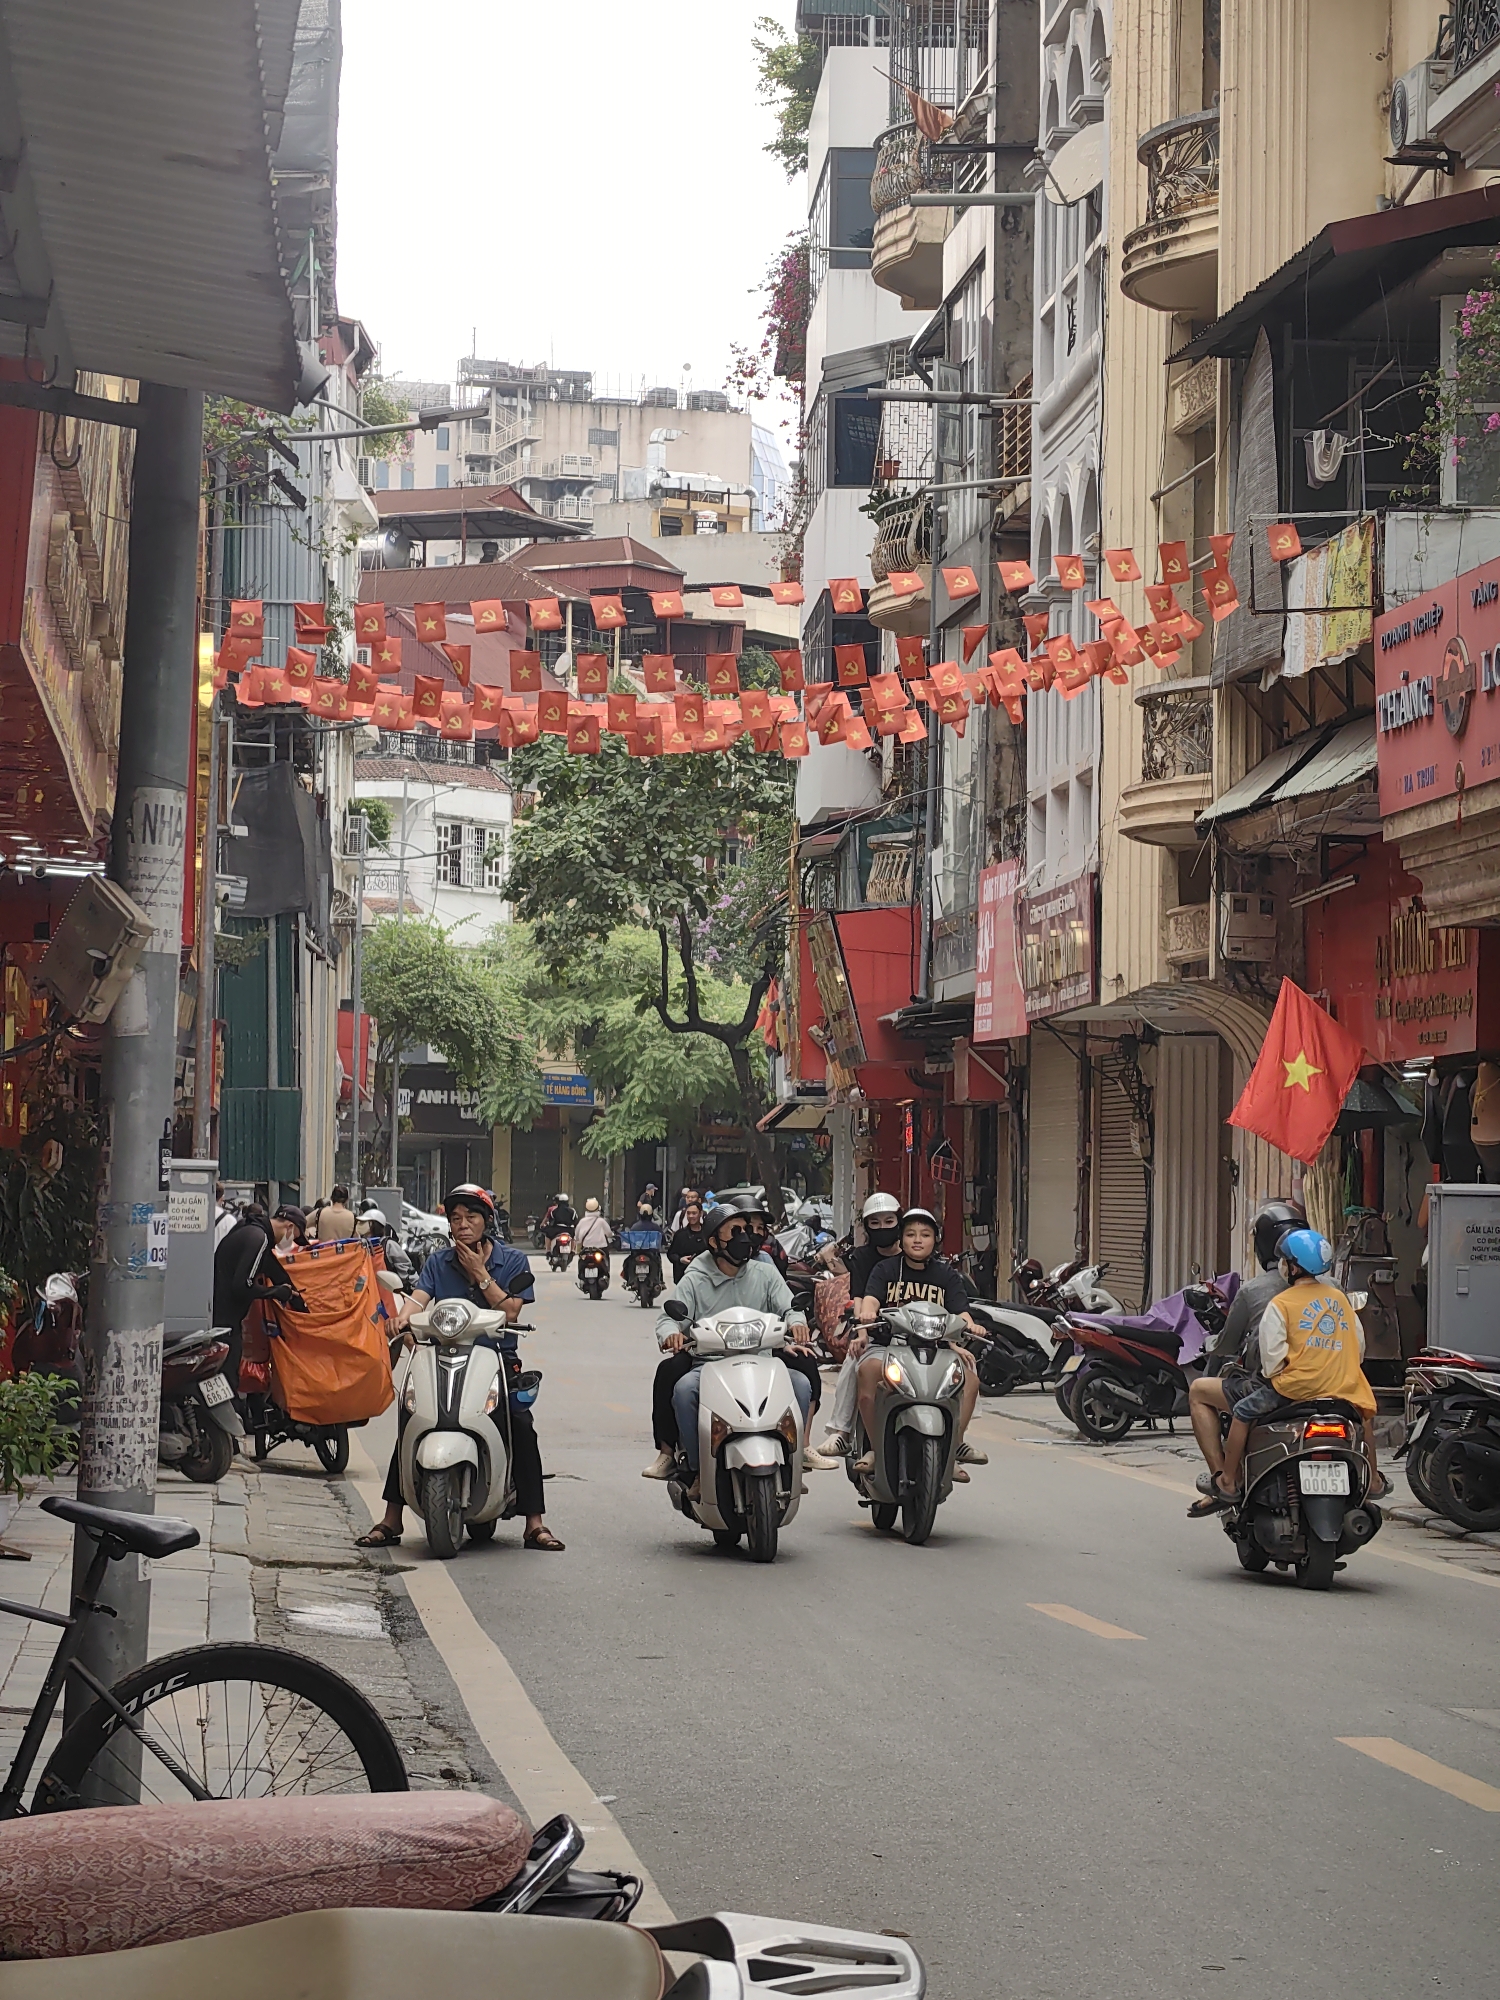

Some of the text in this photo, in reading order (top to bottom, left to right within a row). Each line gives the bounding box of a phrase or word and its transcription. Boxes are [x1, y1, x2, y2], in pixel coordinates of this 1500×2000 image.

[1381, 622, 1410, 649] DOANH
[416, 1089, 448, 1104] ANH
[887, 1281, 945, 1307] HEAVEN
[1299, 1298, 1349, 1331] NEW YORK
[1306, 1336, 1343, 1350] KNICKS
[203, 1376, 225, 1392] 29-C1
[206, 1386, 232, 1404] 686.31
[1307, 1463, 1341, 1478] 17-AG
[1304, 1478, 1346, 1493] 000.51
